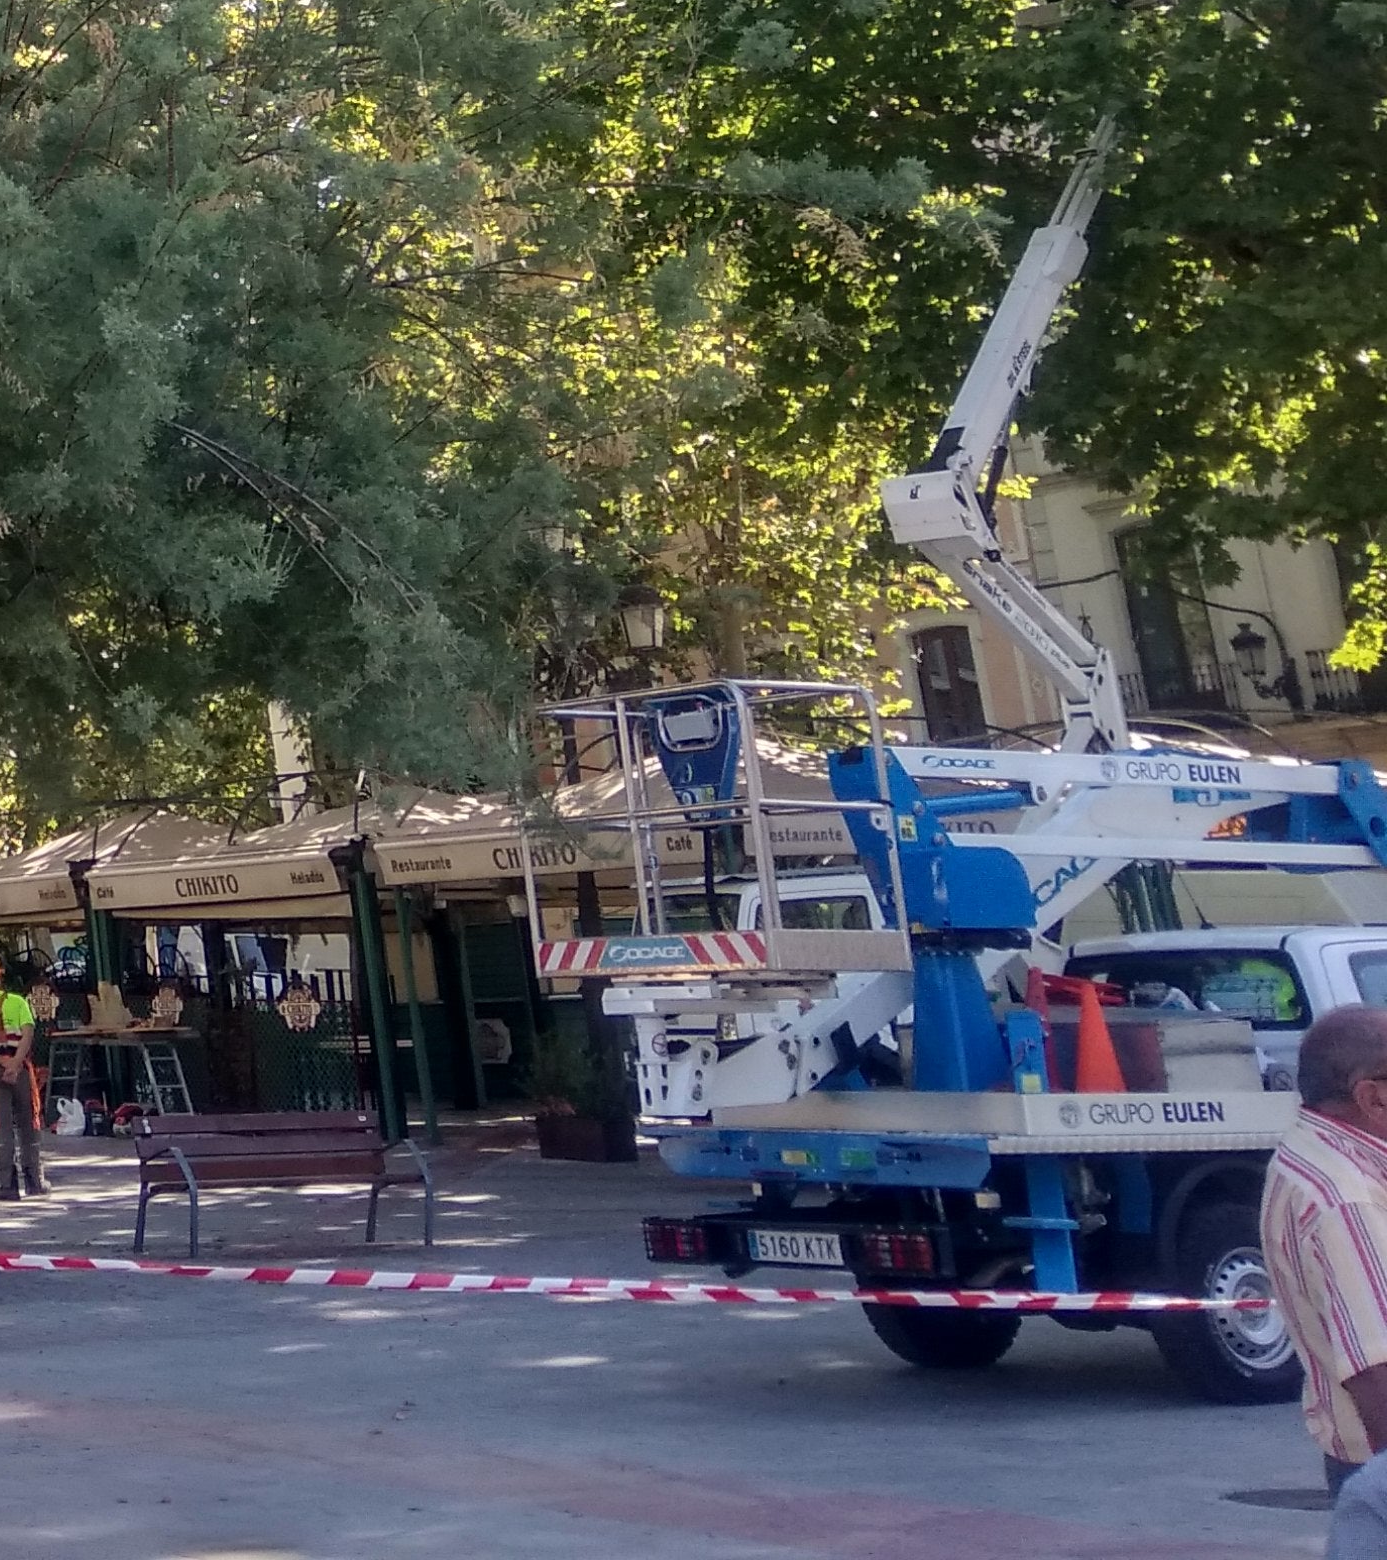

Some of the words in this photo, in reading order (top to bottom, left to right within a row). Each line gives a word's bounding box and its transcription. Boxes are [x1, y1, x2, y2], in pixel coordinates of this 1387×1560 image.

[1126, 760, 1181, 781] GRUPO
[1188, 763, 1242, 784] EULEN
[667, 834, 693, 852] Café
[769, 827, 844, 843] estaurante
[391, 855, 452, 873] Restaurante
[96, 886, 115, 899] Café
[175, 873, 240, 898] CHIKITO
[1088, 1102, 1154, 1124] GRUPO
[1162, 1101, 1225, 1124] EULEN
[758, 1235, 801, 1259] 5160
[804, 1236, 838, 1261] KTK
